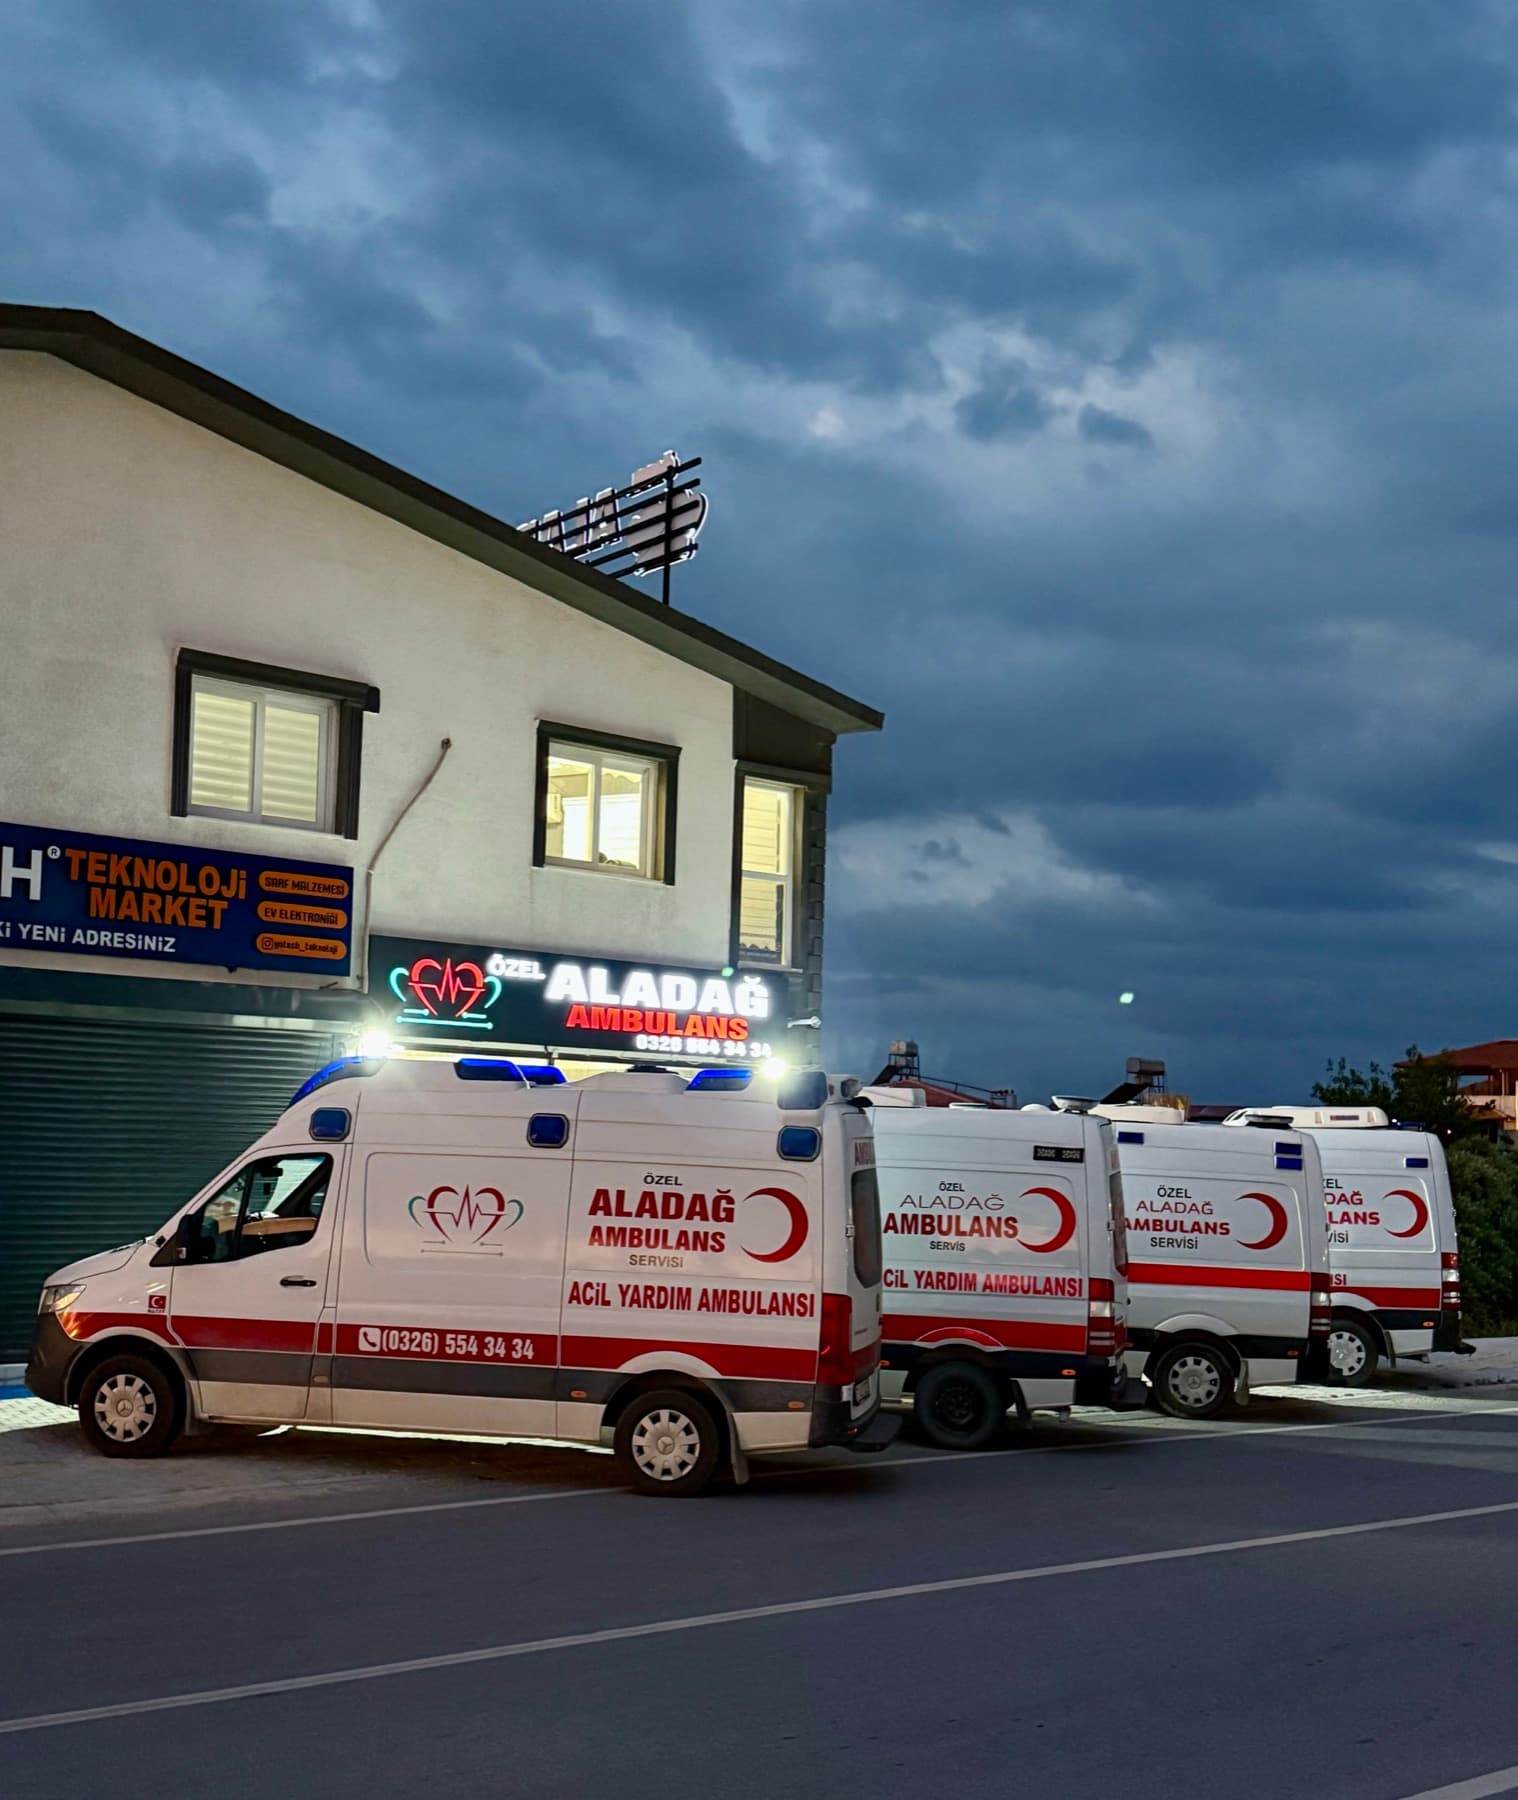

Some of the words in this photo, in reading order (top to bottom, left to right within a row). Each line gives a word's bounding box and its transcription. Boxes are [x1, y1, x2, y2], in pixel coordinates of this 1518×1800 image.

[89, 887, 228, 929] MARKET
[264, 907, 277, 918] EV
[487, 953, 546, 980] ÖZEL
[545, 963, 769, 1018] ALADAĞ
[565, 1004, 749, 1041] AMBULANS
[723, 1040, 746, 1057] 34
[643, 1172, 683, 1186] ÖZEL
[938, 1181, 965, 1192] ÖZEL
[1157, 1184, 1192, 1199] ÖZEL
[588, 1188, 735, 1223] ALADAĞ
[899, 1194, 1005, 1211] ALADAĞ
[1136, 1200, 1214, 1215] ALADAĞ
[588, 1225, 726, 1253] AMBULANS
[883, 1212, 1018, 1239] AMBULANS
[1125, 1217, 1230, 1236] AMBULANS
[1150, 1236, 1198, 1250] SERVİSİ
[914, 1270, 977, 1292] YARDIM
[982, 1274, 1083, 1298] AMBULANSI
[618, 1284, 691, 1311] YARDIM
[697, 1288, 815, 1318] AMBULANSI
[382, 1329, 439, 1355] (0326)
[445, 1333, 478, 1355] 554
[484, 1336, 506, 1357] 34
[512, 1338, 534, 1359] 34
